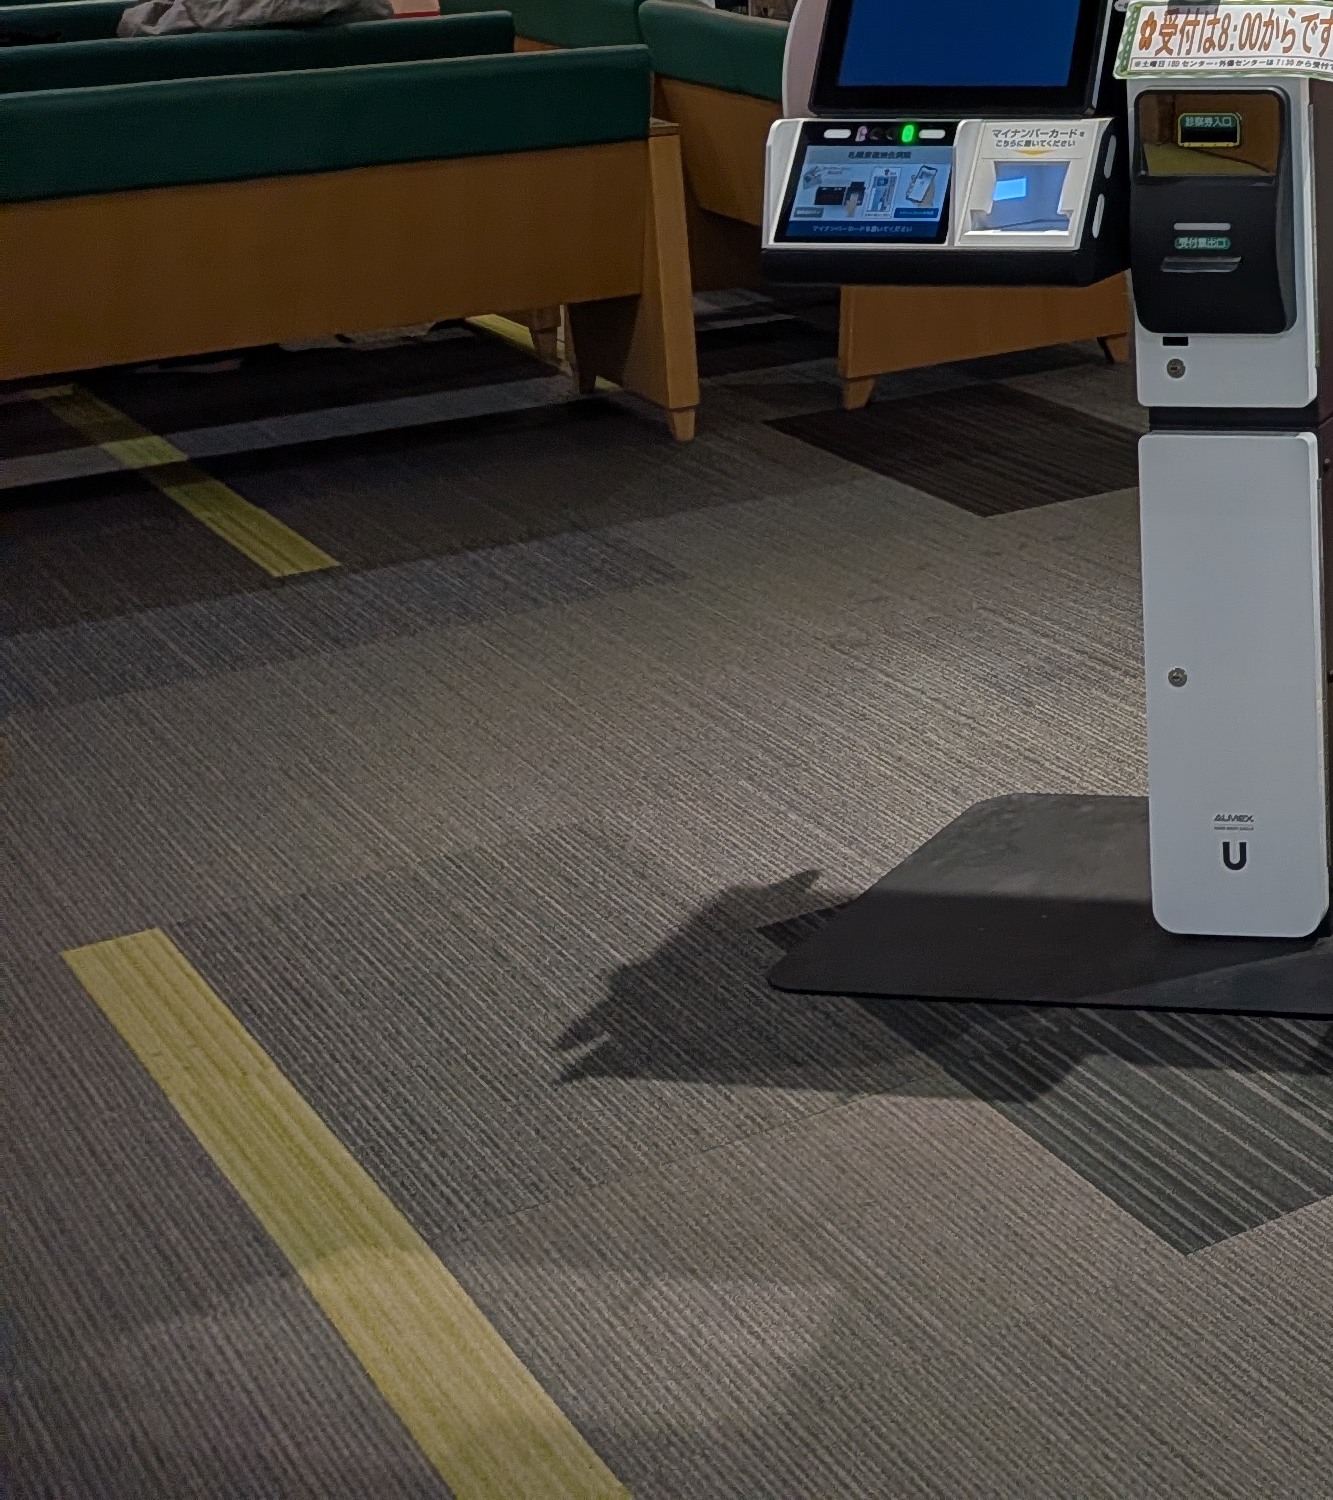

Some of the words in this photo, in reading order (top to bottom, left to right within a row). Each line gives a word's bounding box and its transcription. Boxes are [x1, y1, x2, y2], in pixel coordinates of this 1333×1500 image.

[1185, 115, 1233, 128] 診察券入口
[992, 128, 1086, 139] マイナンバーカードを
[995, 139, 1077, 149] こちらに置いてください
